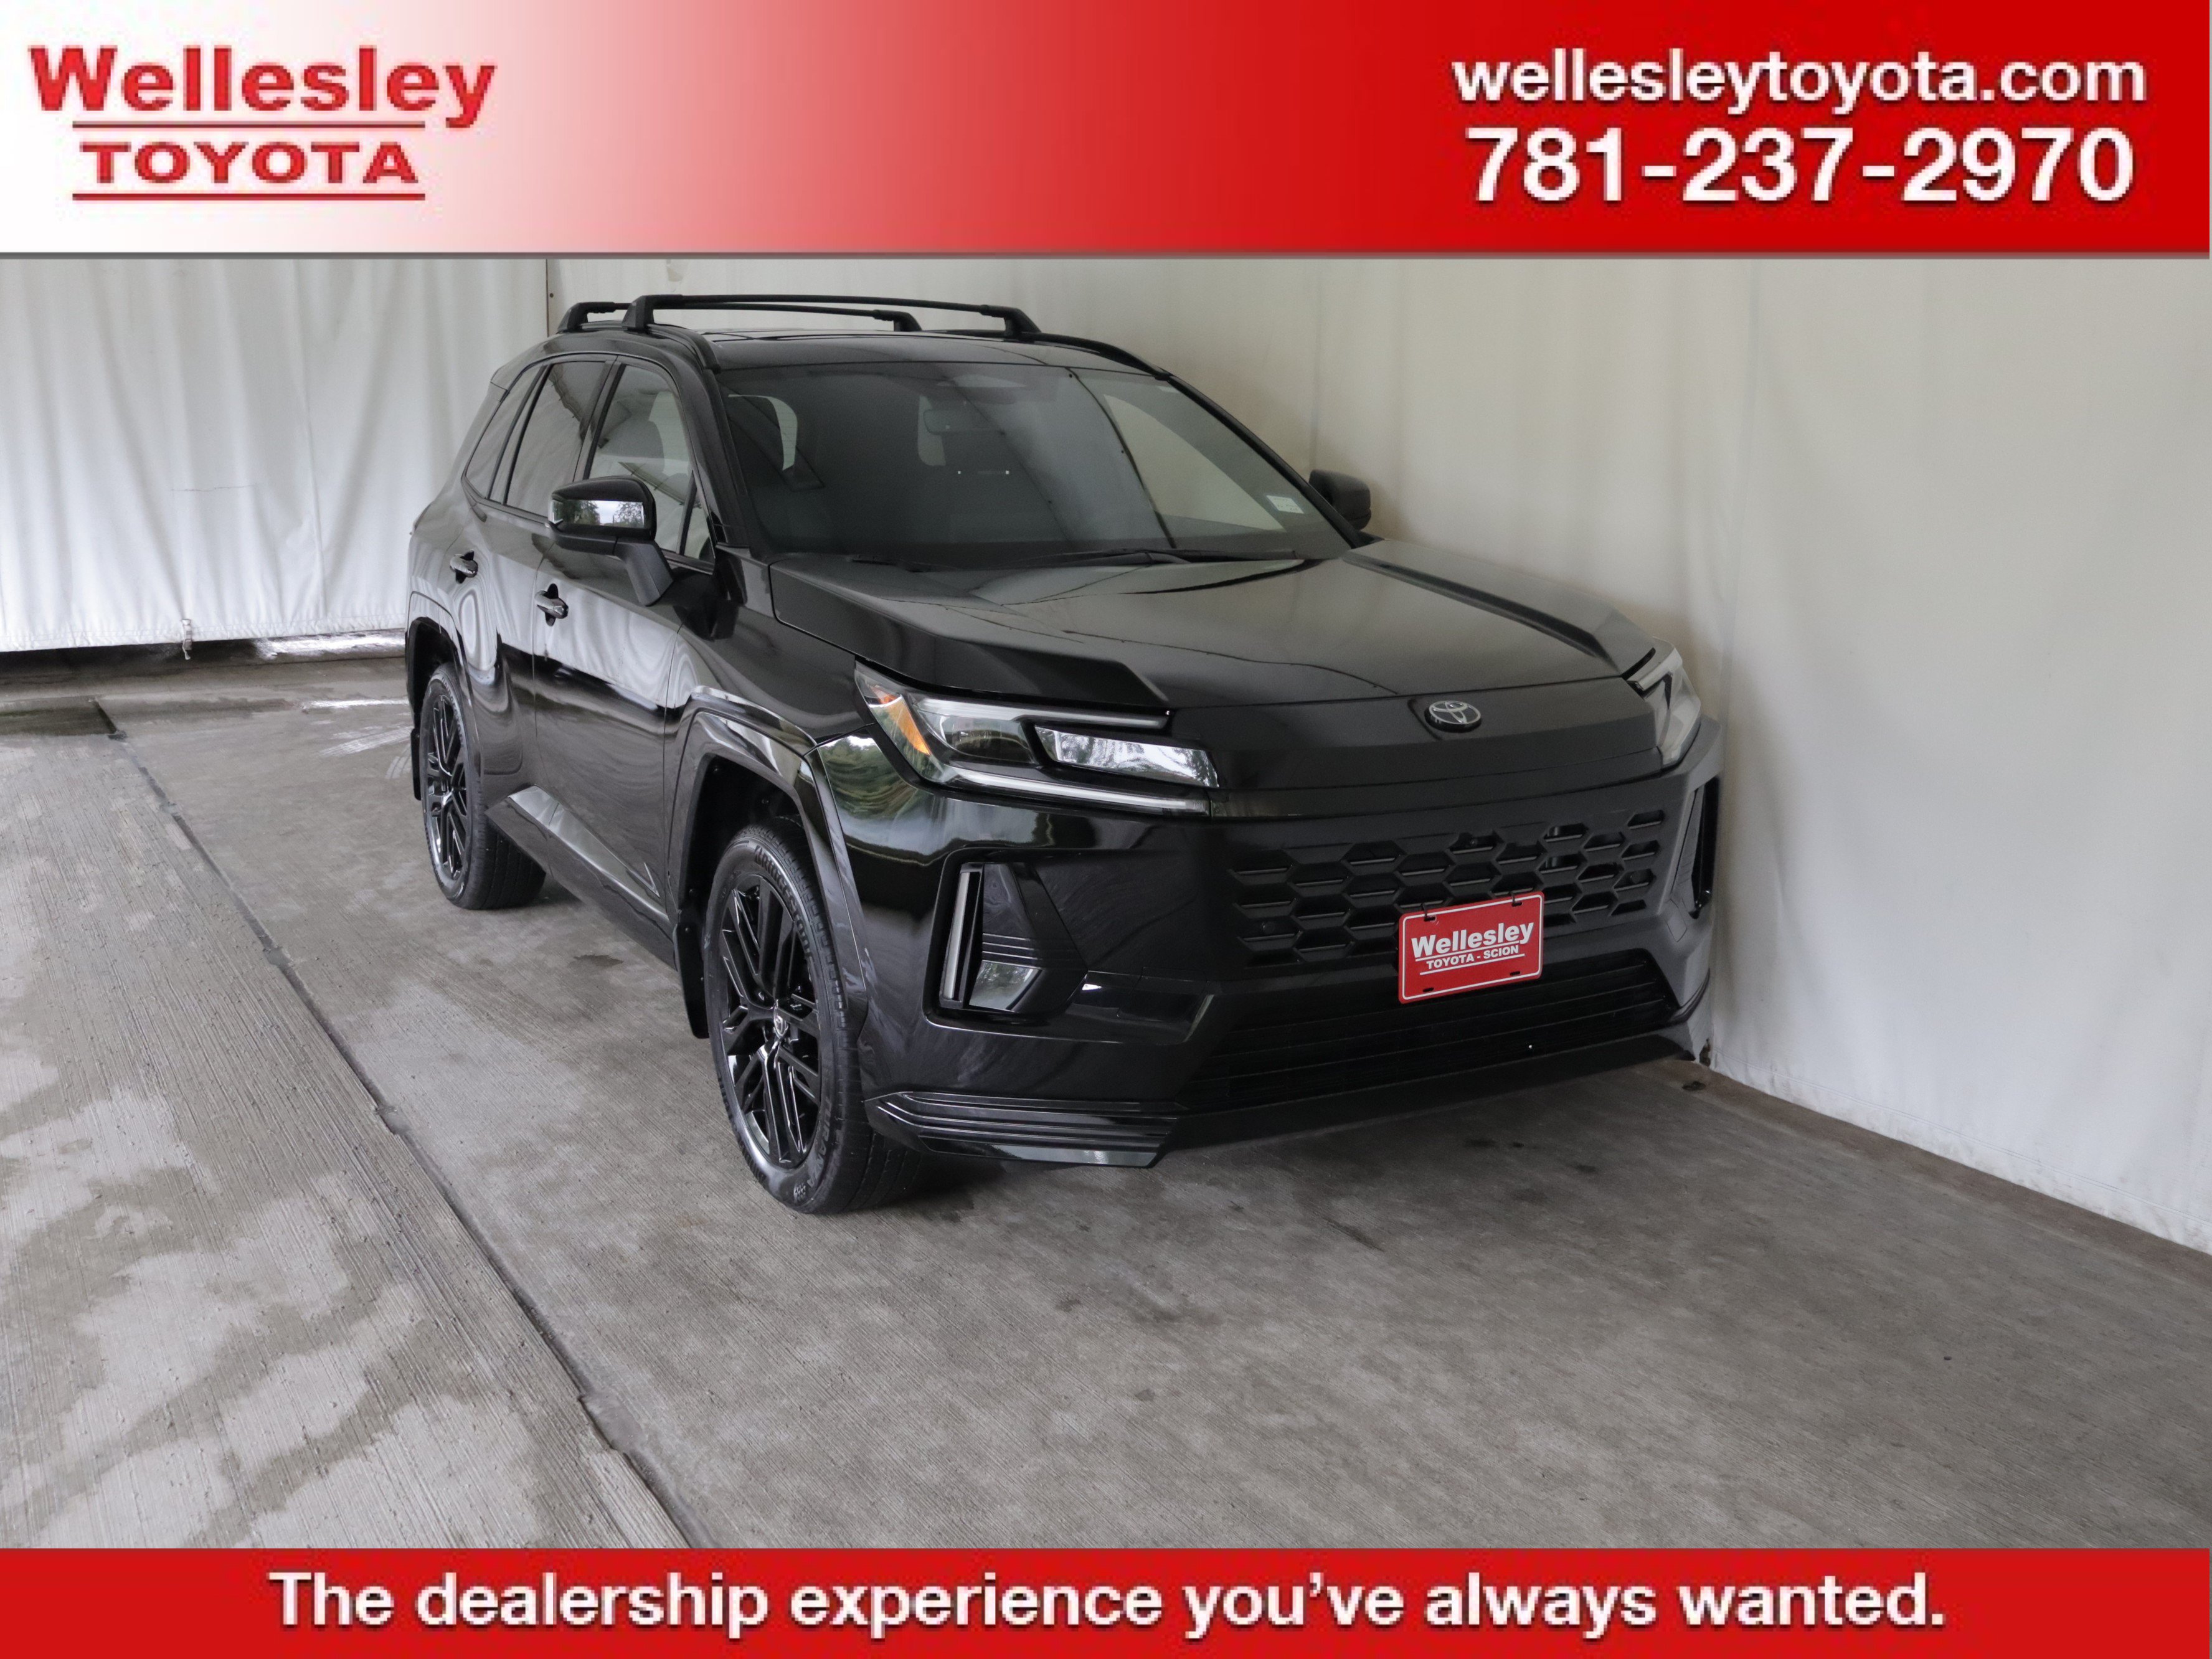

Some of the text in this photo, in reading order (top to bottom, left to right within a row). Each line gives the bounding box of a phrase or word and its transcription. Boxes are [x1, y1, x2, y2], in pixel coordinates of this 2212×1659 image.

[1411, 922, 1534, 958] Wellesley
[1426, 953, 1474, 969] TOYOTA
[1483, 945, 1519, 959] SCION
